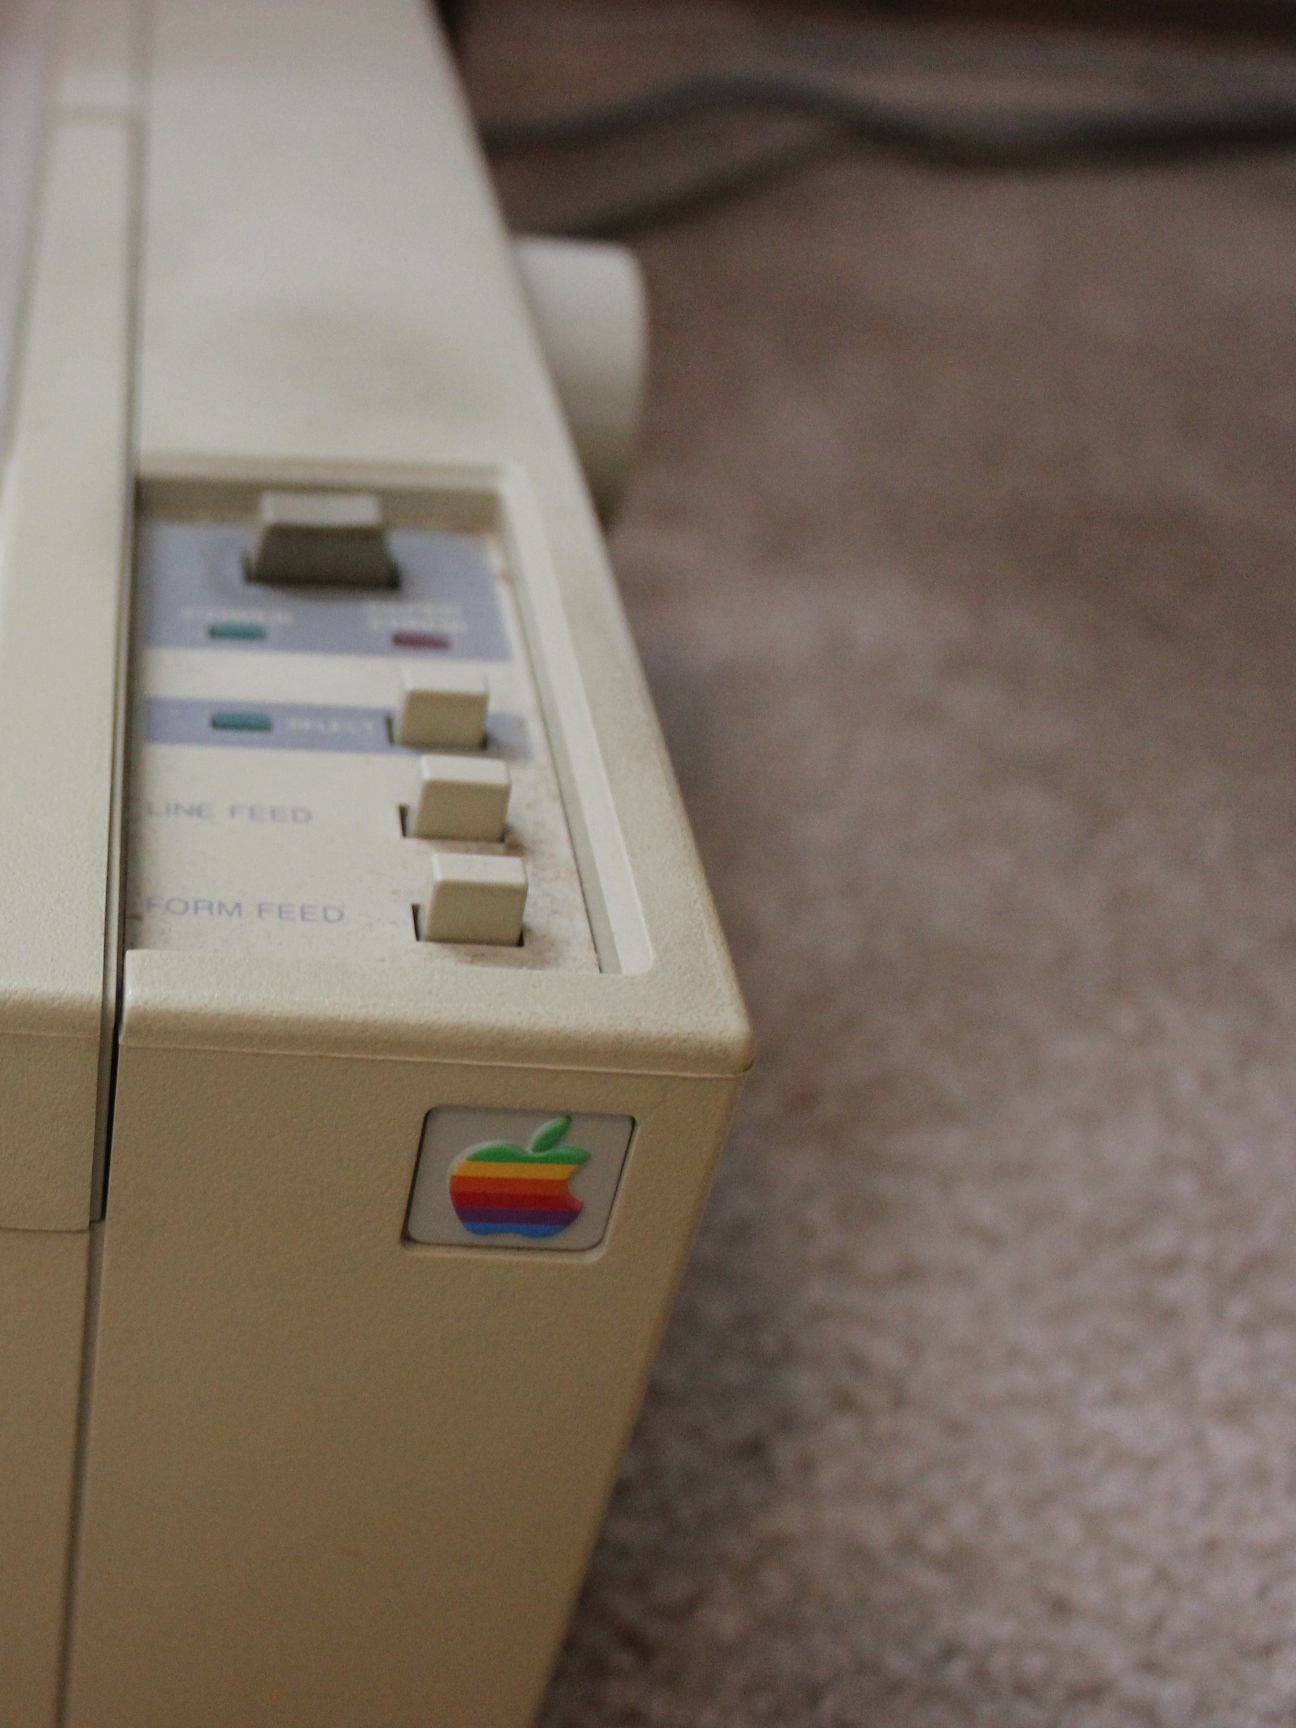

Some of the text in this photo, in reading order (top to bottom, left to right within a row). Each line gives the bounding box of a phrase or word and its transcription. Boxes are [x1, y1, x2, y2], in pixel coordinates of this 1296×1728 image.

[147, 801, 314, 824] LINE FEED
[146, 896, 345, 923] FORM FEED
